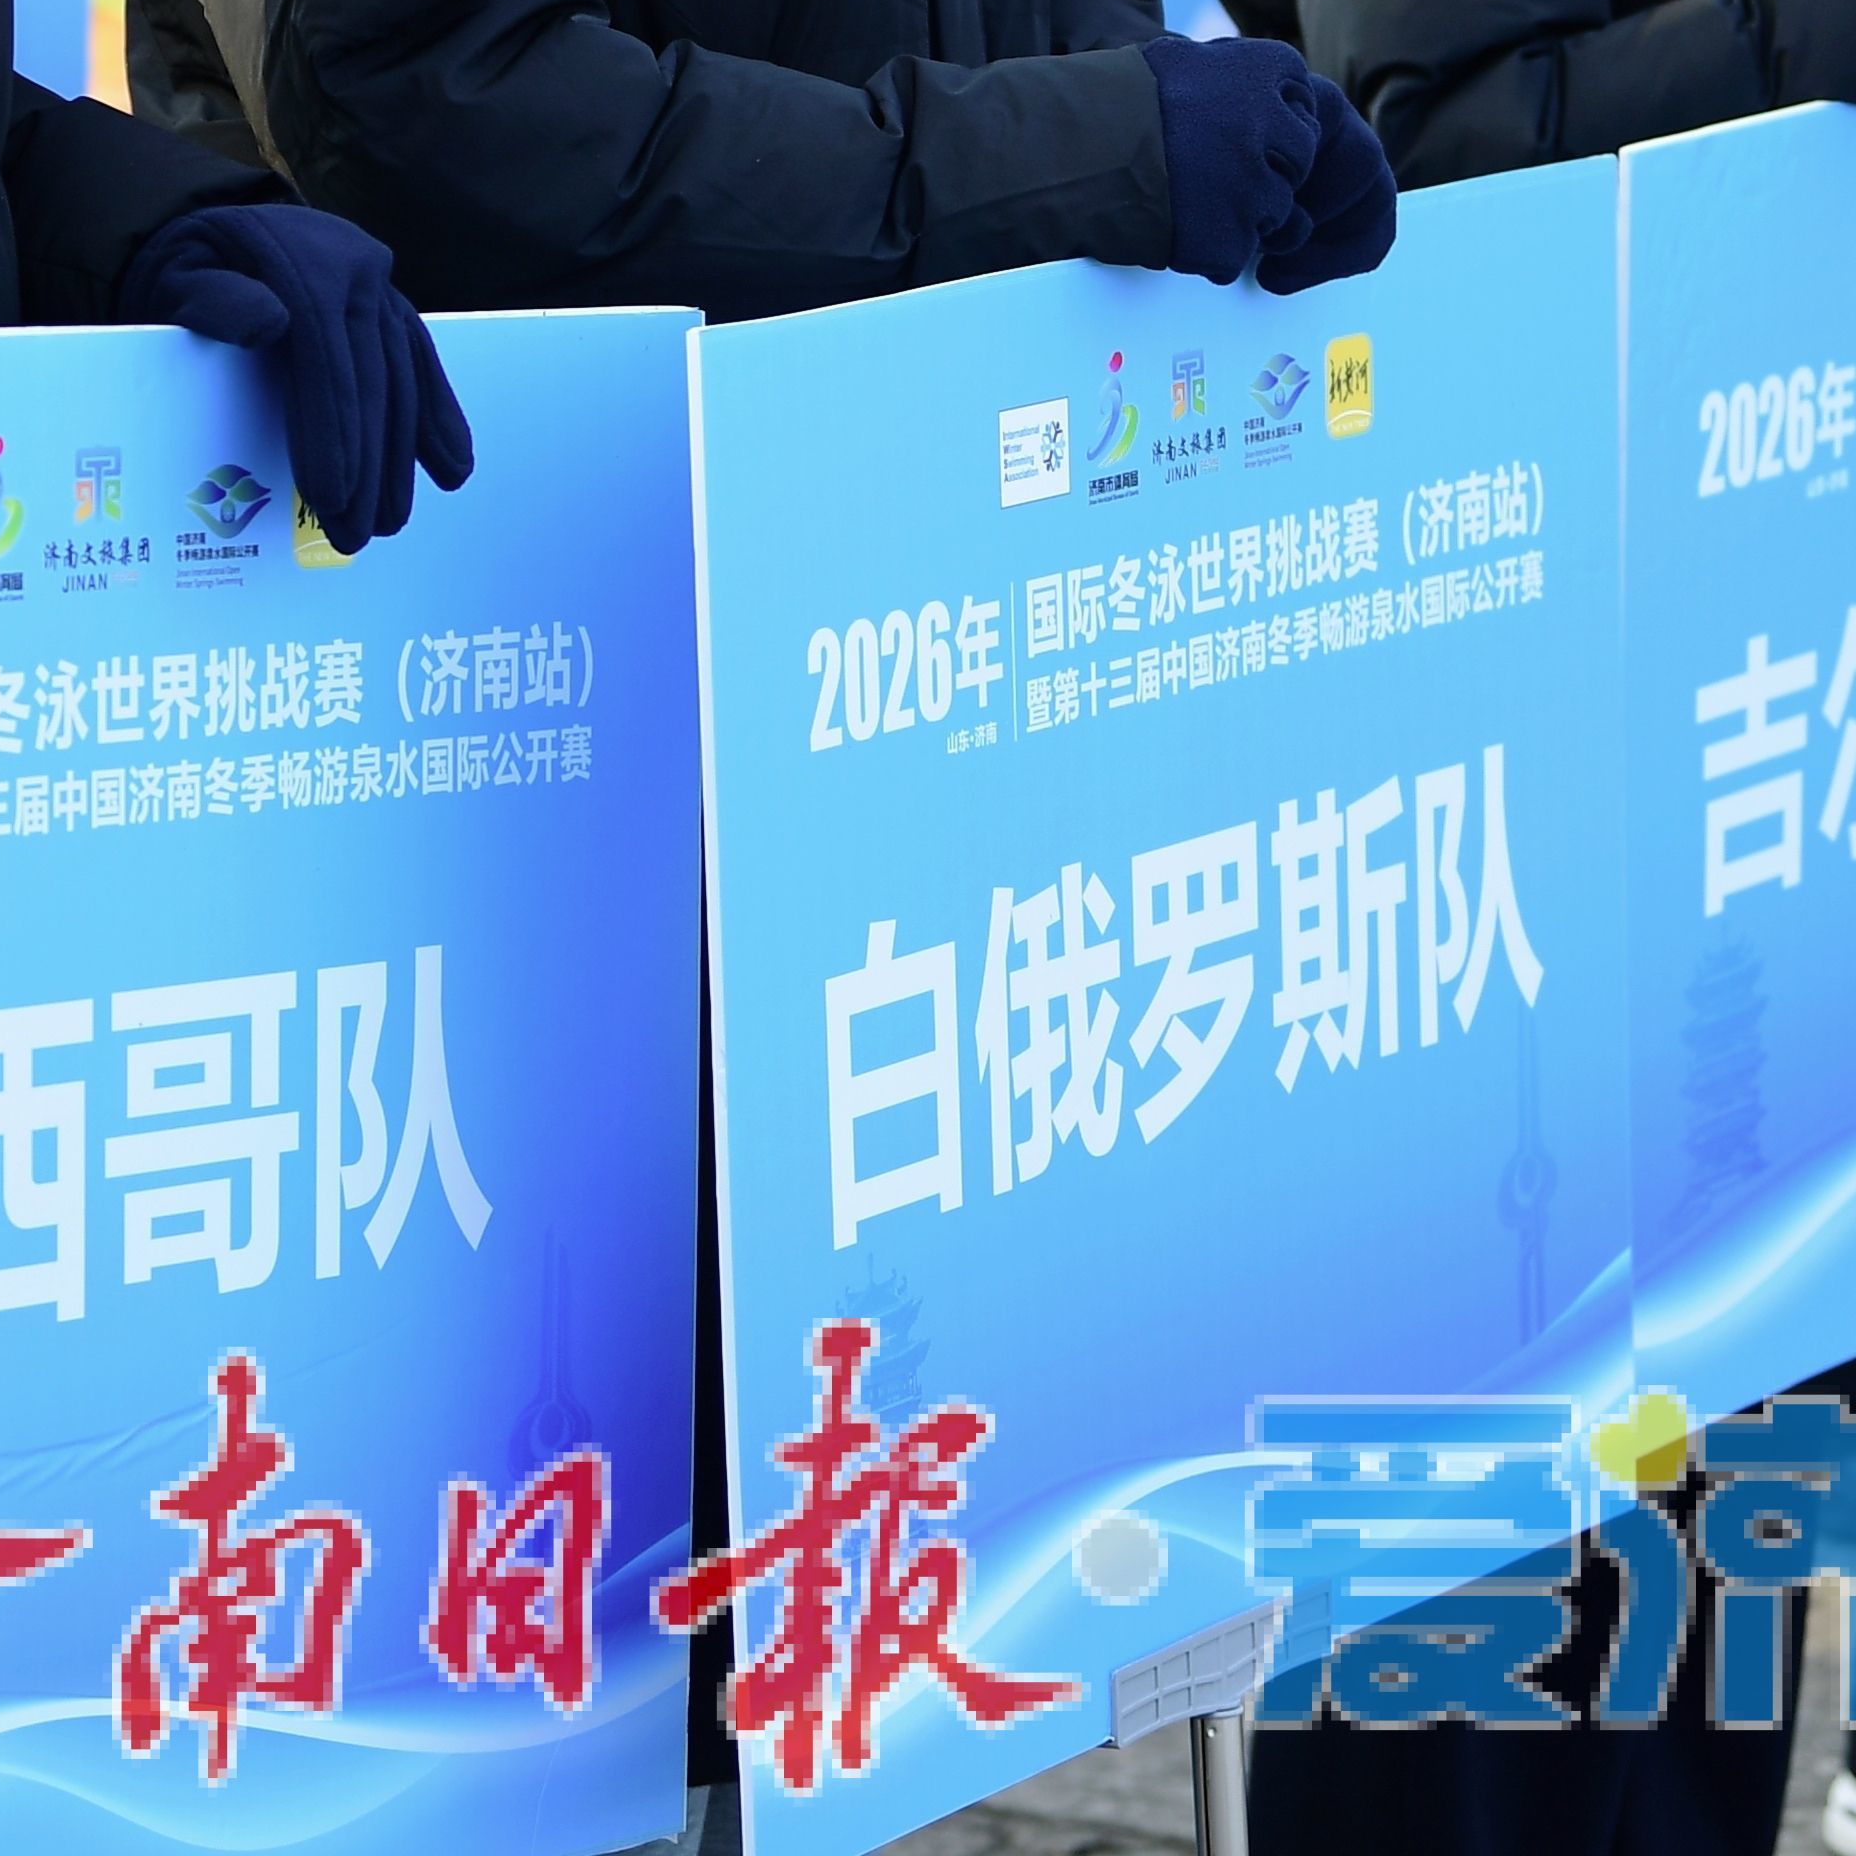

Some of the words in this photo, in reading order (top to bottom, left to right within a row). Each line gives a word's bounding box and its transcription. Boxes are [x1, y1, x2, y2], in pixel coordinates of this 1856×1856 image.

[1165, 463, 1197, 485] JINAN
[1698, 361, 1856, 497] 2026年
[62, 574, 108, 593] JINAN
[1026, 461, 1544, 651] 国际冬泳世界挑战赛（济南站）
[808, 593, 1005, 752] 2026年
[1025, 549, 1544, 736] 暨第十三届中国济南冬季畅游泉水国际公开赛
[946, 721, 998, 755] 山东·济南
[824, 742, 1545, 1251] 白俄罗斯队
